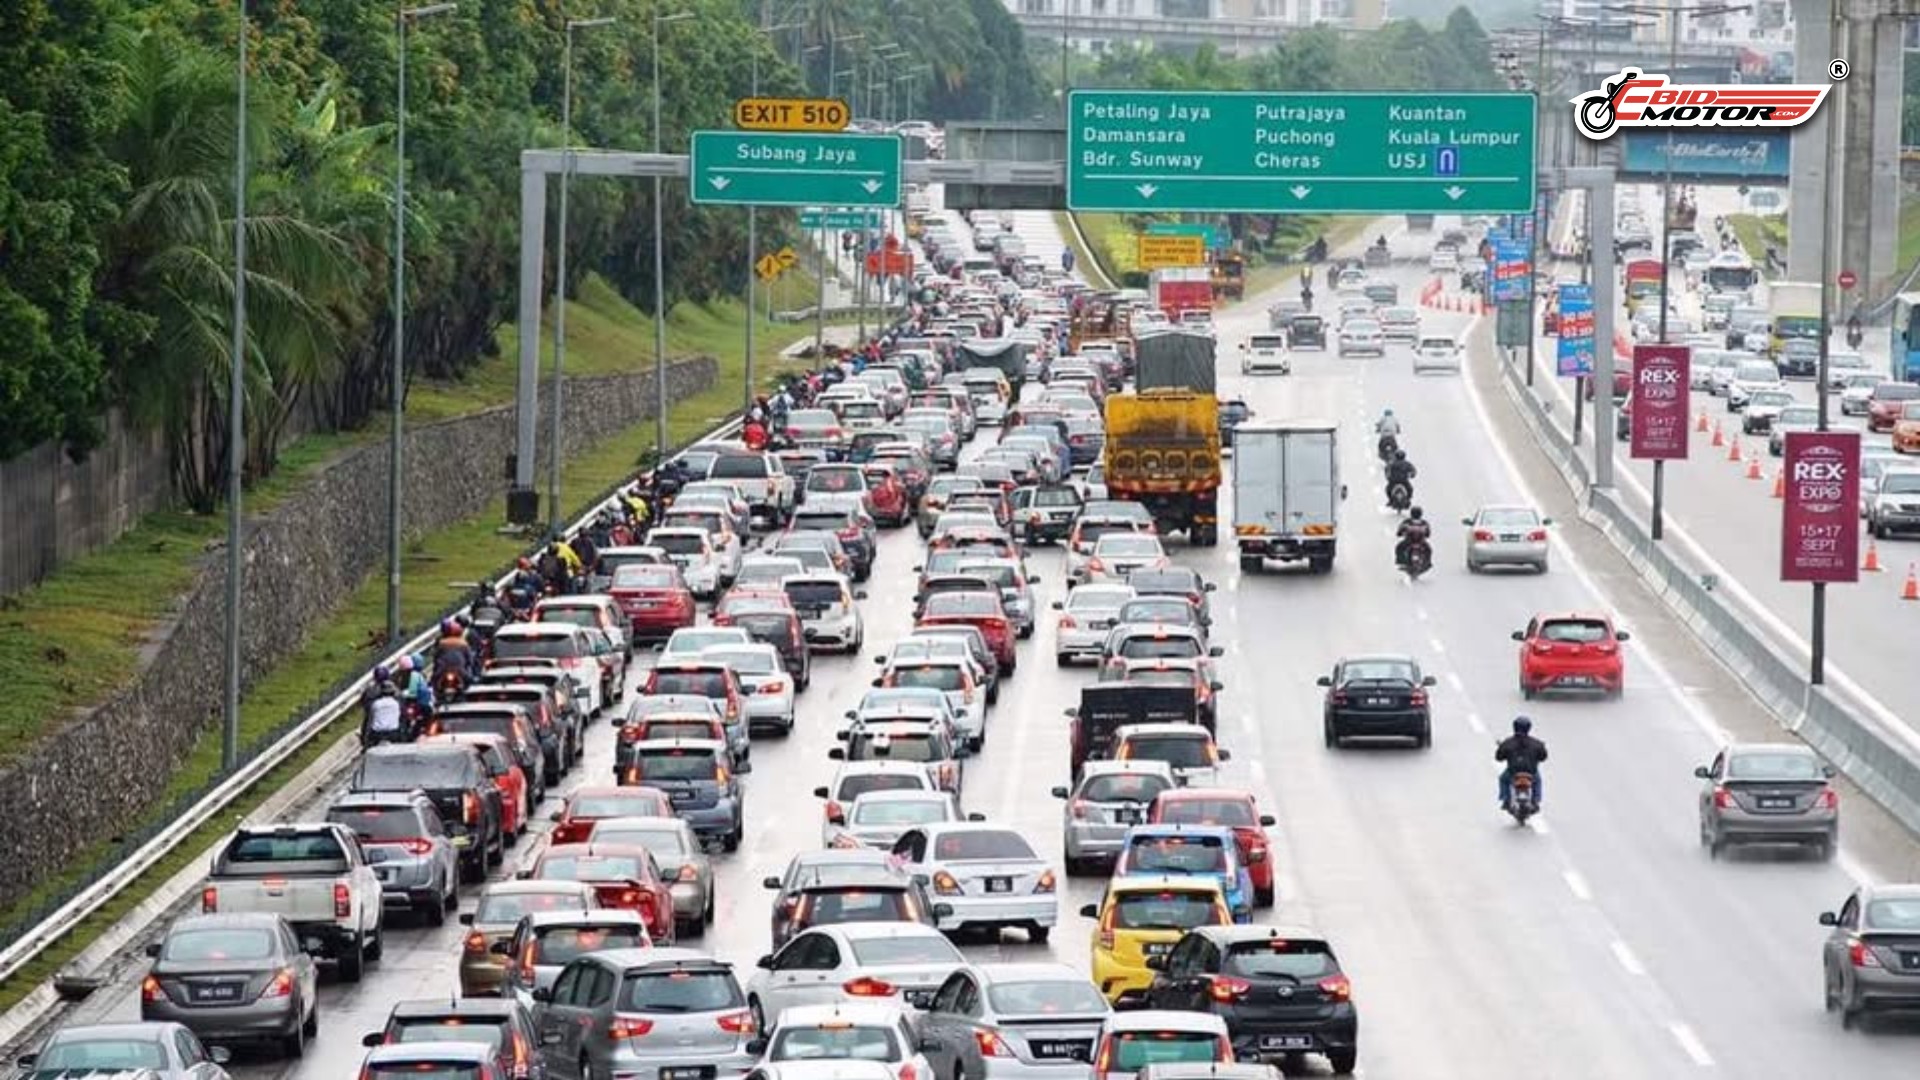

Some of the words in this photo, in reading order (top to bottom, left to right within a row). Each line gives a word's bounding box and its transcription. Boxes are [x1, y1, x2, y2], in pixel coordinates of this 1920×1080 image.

[741, 105, 792, 123] EXIT
[803, 105, 841, 124] 510
[1084, 103, 1159, 121] Petaling
[1168, 103, 1211, 121] Jaya
[1256, 104, 1345, 122] Putrajaya
[1389, 105, 1466, 121] Kuantan
[1083, 127, 1186, 143] Damansara
[1255, 128, 1335, 147] Puchong
[1389, 129, 1440, 145] Kuala
[1450, 129, 1519, 147] Lumpur
[737, 143, 806, 163] Subang
[815, 146, 857, 164] Jaya
[1083, 151, 1121, 167] Bdr.
[1130, 151, 1203, 169] Sunway
[1255, 152, 1321, 168] Cheras
[1388, 153, 1426, 169] USJ
[1800, 485, 1841, 500] EXPO
[1802, 538, 1836, 551] SEPT
